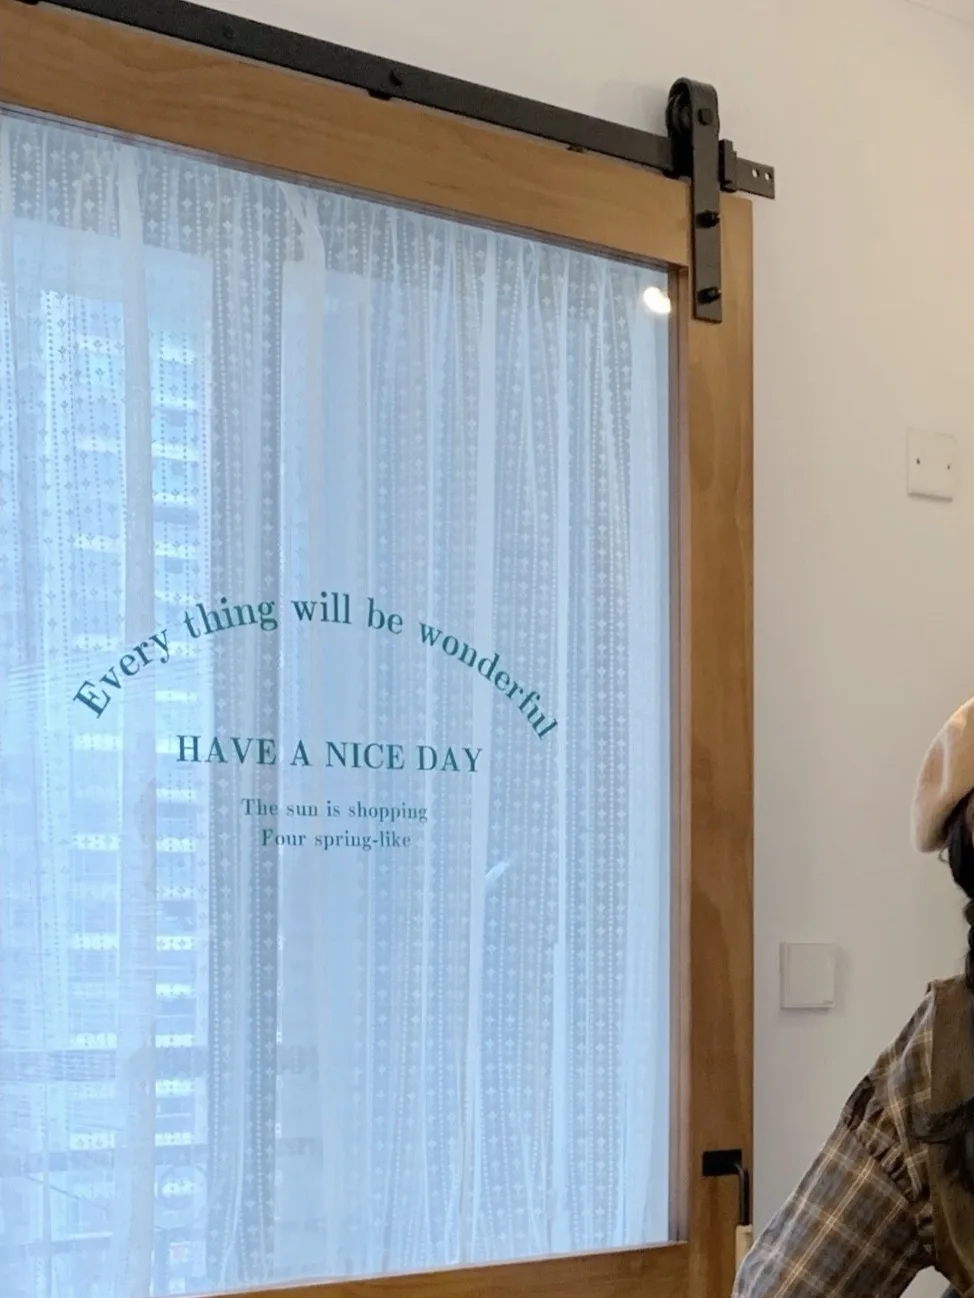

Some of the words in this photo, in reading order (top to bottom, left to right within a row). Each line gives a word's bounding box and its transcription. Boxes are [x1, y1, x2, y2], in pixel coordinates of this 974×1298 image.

[73, 628, 174, 719] Every
[184, 596, 279, 639] thing
[291, 591, 352, 624] will
[367, 598, 404, 634] be
[418, 621, 558, 741] wonderful
[175, 734, 277, 766] HAVE
[290, 740, 312, 767] A
[325, 741, 405, 771] NICE
[416, 745, 484, 773] DAY
[241, 798, 278, 816] The
[286, 805, 318, 817] sun
[326, 800, 340, 817] is
[348, 801, 428, 822] shopping
[261, 828, 306, 847] Four
[314, 830, 411, 851] spring-like
